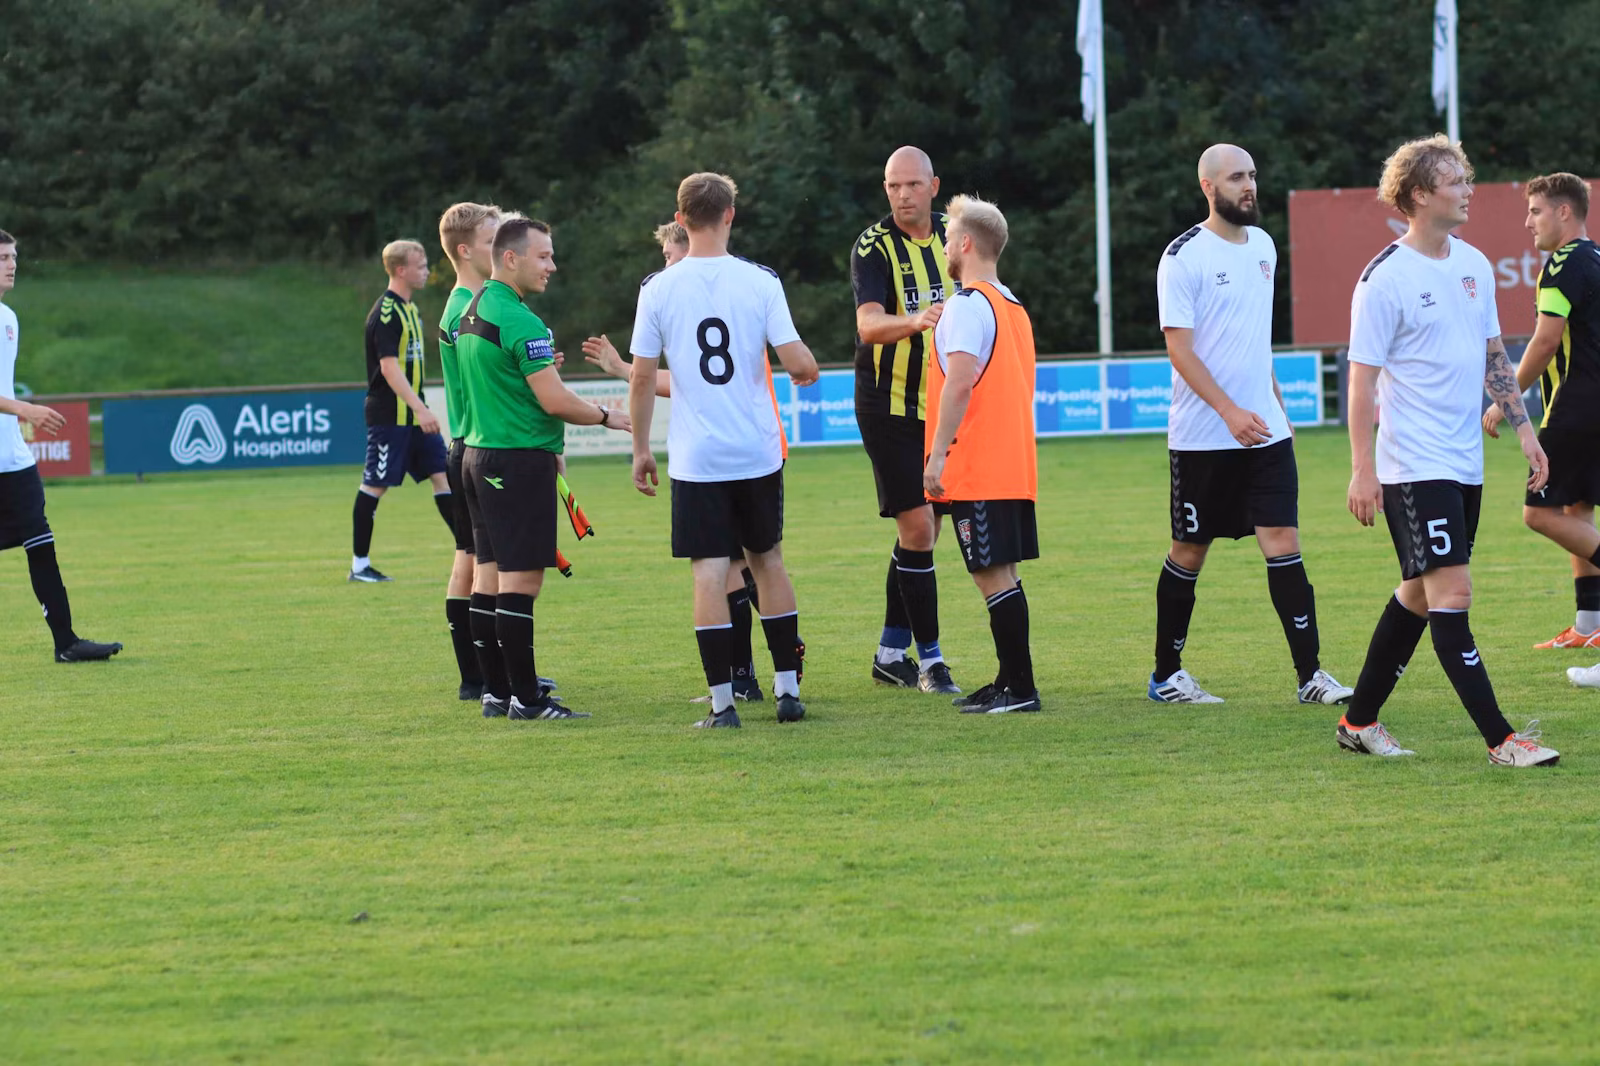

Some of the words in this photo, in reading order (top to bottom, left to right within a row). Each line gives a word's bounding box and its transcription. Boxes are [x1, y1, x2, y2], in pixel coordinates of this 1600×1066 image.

[697, 317, 735, 386] 8
[233, 402, 331, 436] Aleris
[233, 437, 331, 459] Hospitaler
[1184, 502, 1199, 533] 3
[1427, 518, 1452, 556] 5
